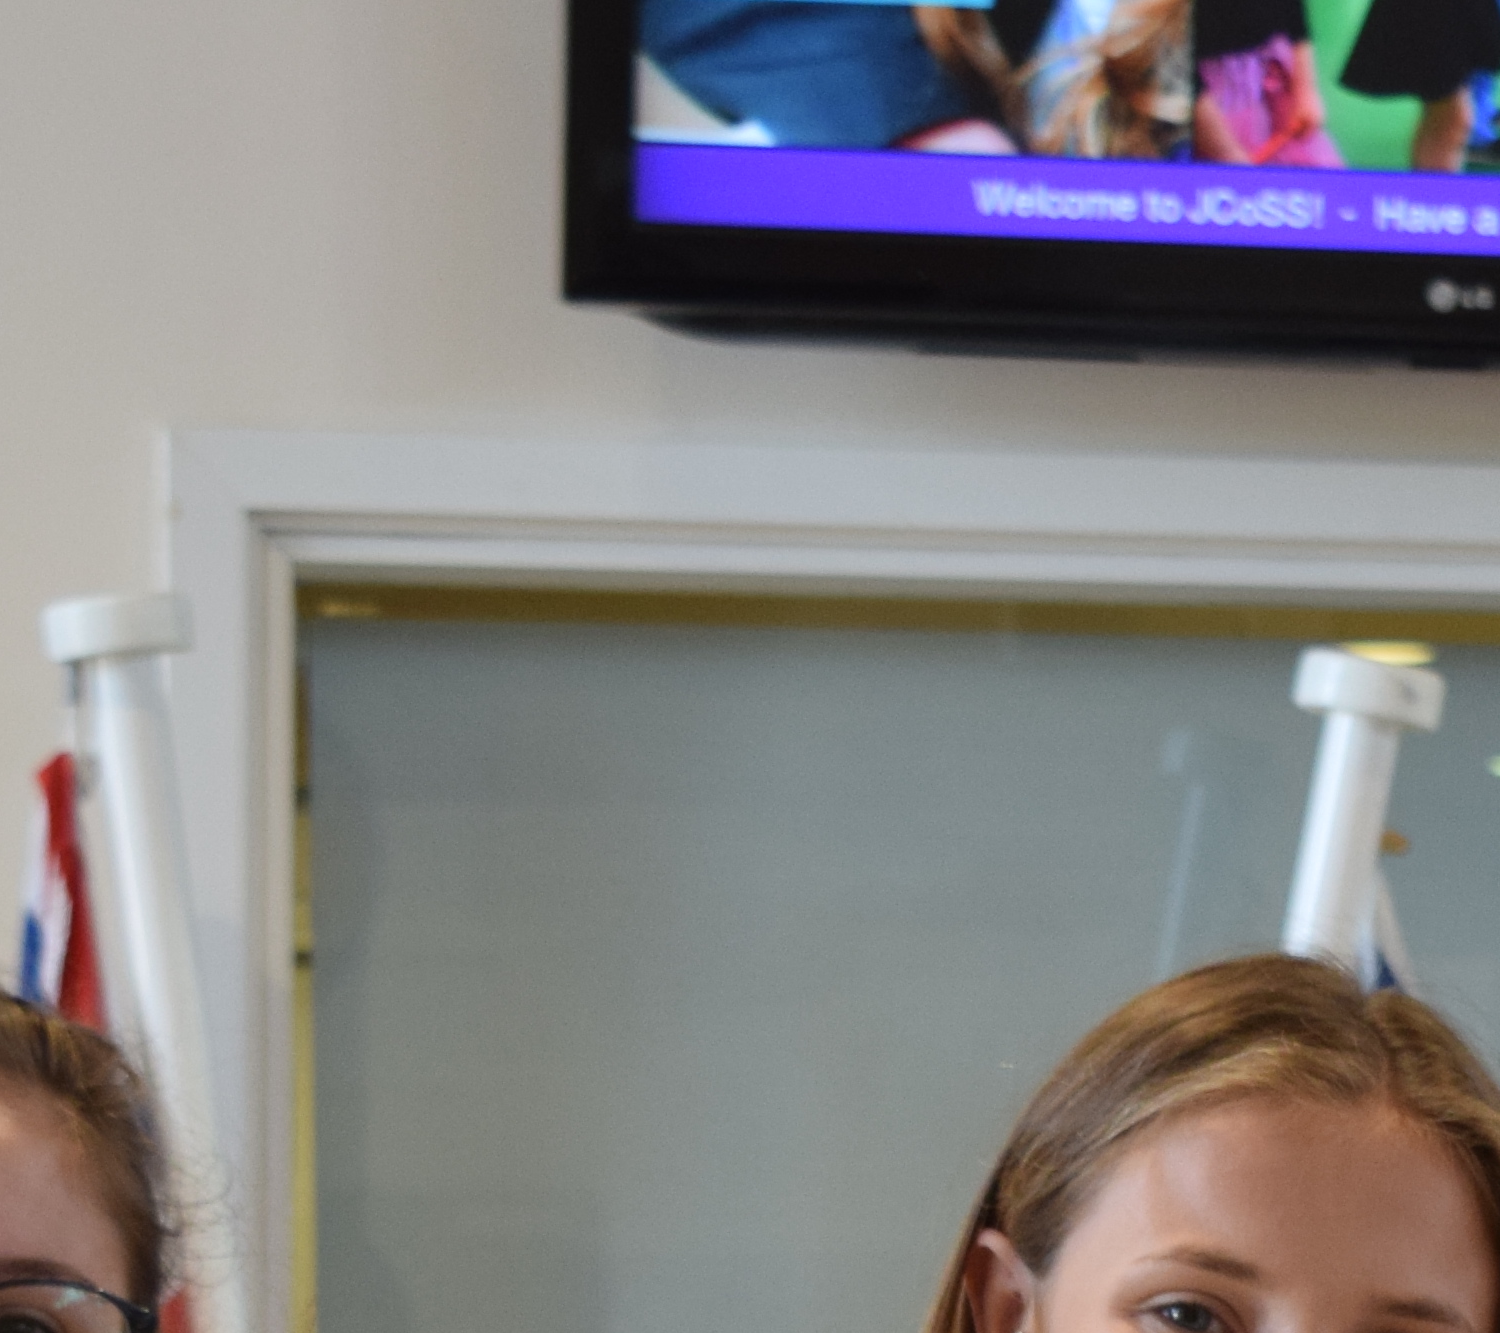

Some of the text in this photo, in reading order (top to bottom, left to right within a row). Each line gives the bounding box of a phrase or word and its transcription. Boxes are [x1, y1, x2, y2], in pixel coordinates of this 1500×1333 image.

[971, 181, 1138, 222] Welcome
[1143, 189, 1184, 224] to
[1372, 195, 1468, 236] Have
[1473, 205, 1500, 237] a
